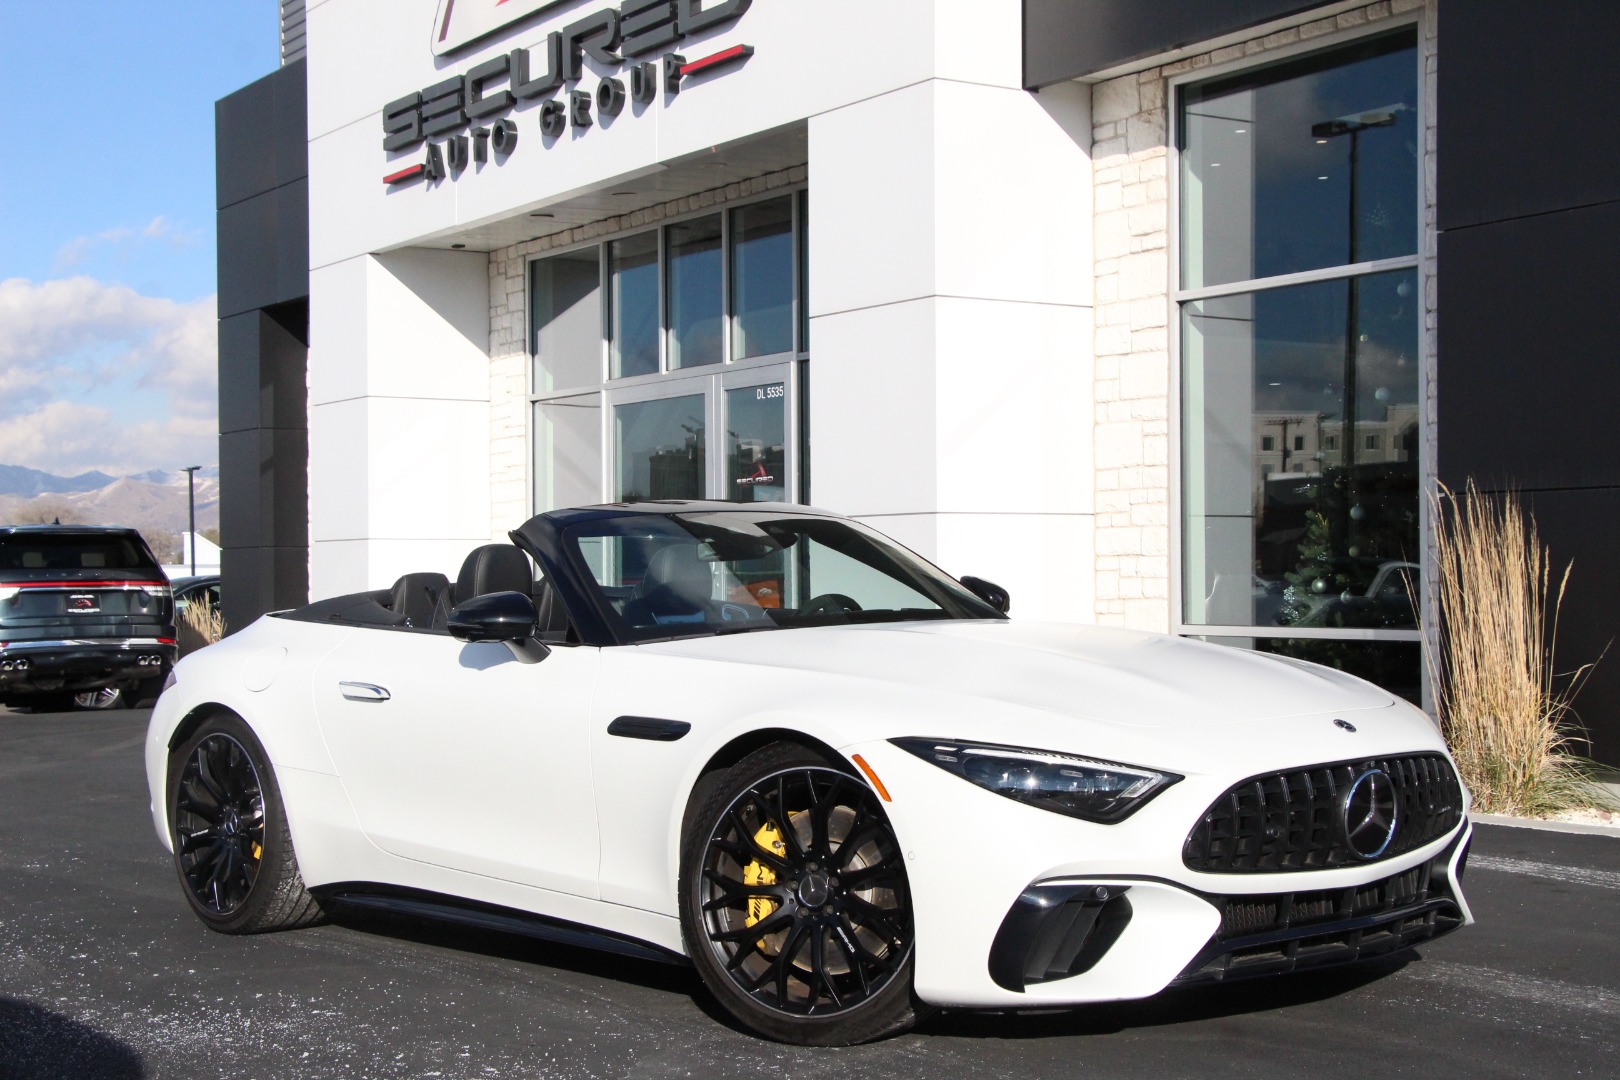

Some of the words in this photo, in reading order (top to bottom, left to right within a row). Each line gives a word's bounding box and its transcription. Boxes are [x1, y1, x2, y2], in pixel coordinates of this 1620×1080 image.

[423, 118, 518, 180] AUTO
[539, 53, 687, 137] GROUP
[756, 388, 766, 400] DL
[767, 385, 783, 398] 5535
